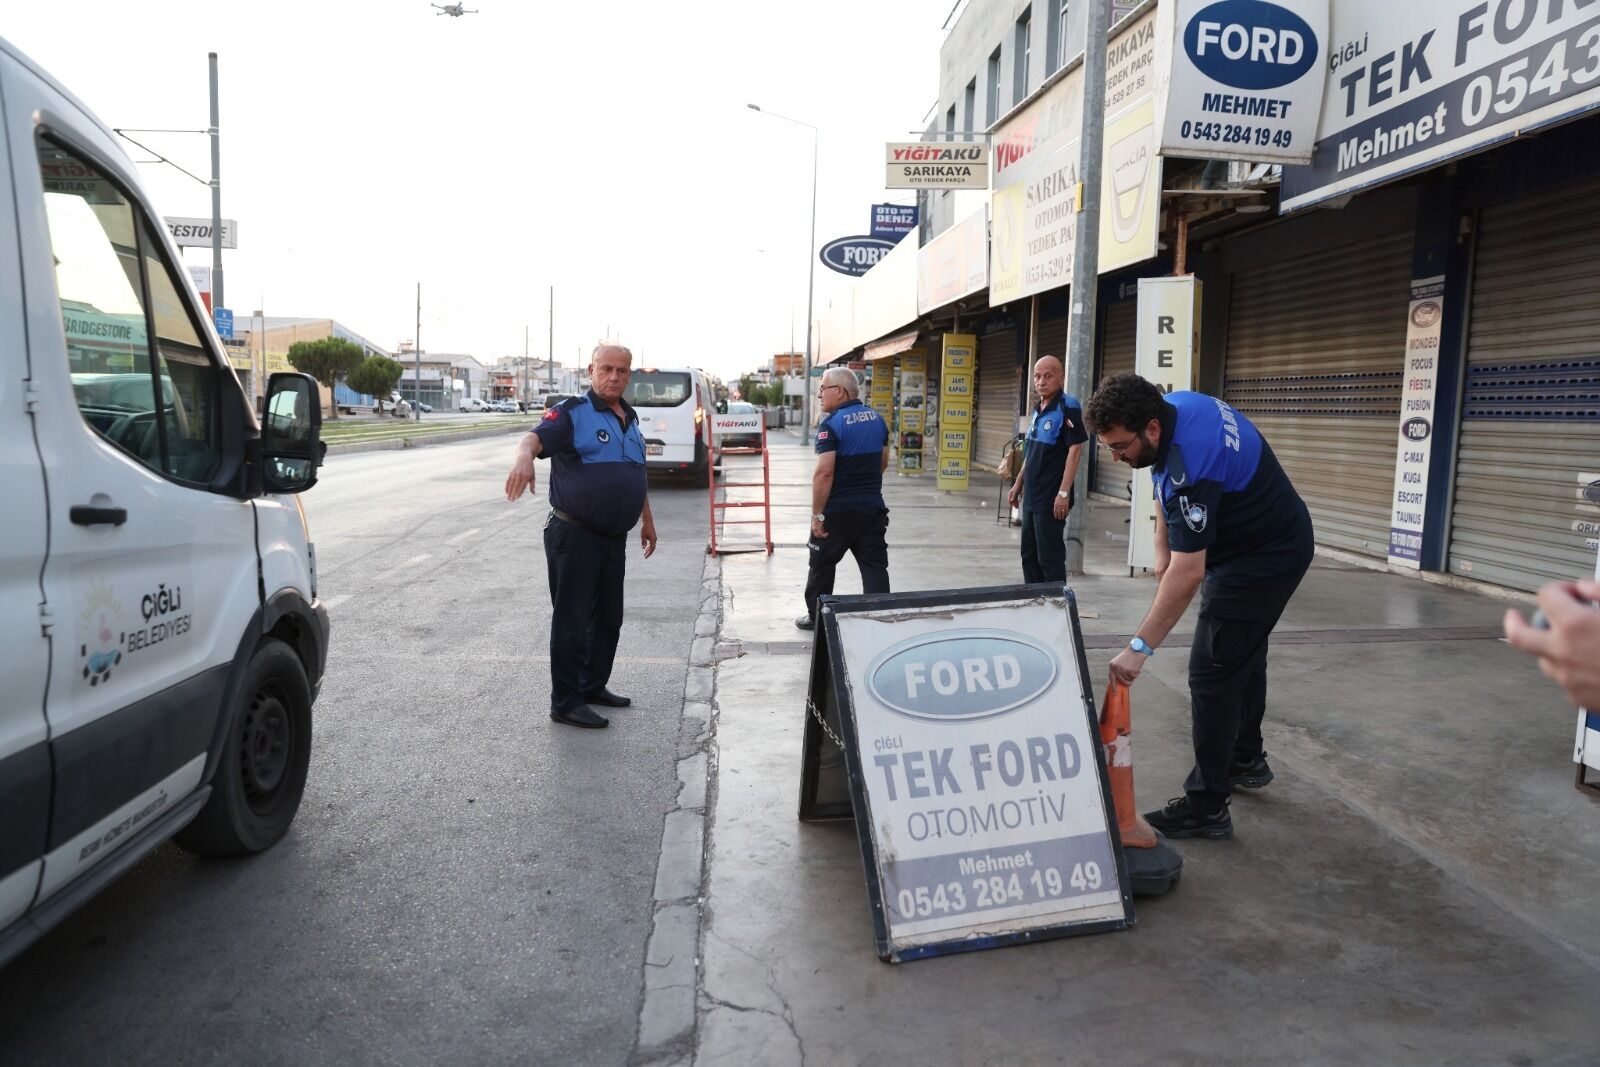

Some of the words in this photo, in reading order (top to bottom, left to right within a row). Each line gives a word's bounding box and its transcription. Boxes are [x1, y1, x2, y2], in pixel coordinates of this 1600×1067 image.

[1196, 21, 1304, 65] FORD
[1329, 32, 1369, 73] ÇİĞLİ
[1339, 28, 1437, 118] TEK
[1202, 93, 1292, 119] MEHMET
[1181, 120, 1191, 139] 0
[1193, 122, 1222, 141] 543
[1222, 125, 1252, 145] 284
[1255, 127, 1271, 146] 19
[1272, 130, 1293, 149] 49
[1337, 101, 1448, 173] Mehmet
[893, 145, 981, 161] YİĞİTAKÜ
[903, 166, 972, 176] SARIKAYA
[876, 207, 898, 215] OTO
[876, 214, 913, 224] DENİZ
[1410, 336, 1438, 350] MONDEO
[1411, 358, 1433, 370] FOCUS
[1408, 422, 1427, 437] FORD
[1403, 451, 1424, 464] C-MAX
[1403, 472, 1421, 484] KUGA
[1397, 491, 1423, 504] ESCORT
[1396, 511, 1421, 525] TAUNUS
[126, 613, 192, 654] BELEDİYESİ
[903, 655, 1021, 699] FORD
[874, 735, 903, 754] ÇİĞLİ
[874, 747, 962, 801] TEK
[970, 733, 1081, 791] FORD
[907, 789, 1066, 841] OTOMOTİV
[958, 849, 1034, 876] Mehmet
[898, 882, 967, 920] 0543
[972, 873, 1025, 907] 284
[1030, 867, 1063, 898] 19
[1070, 861, 1102, 891] 49
